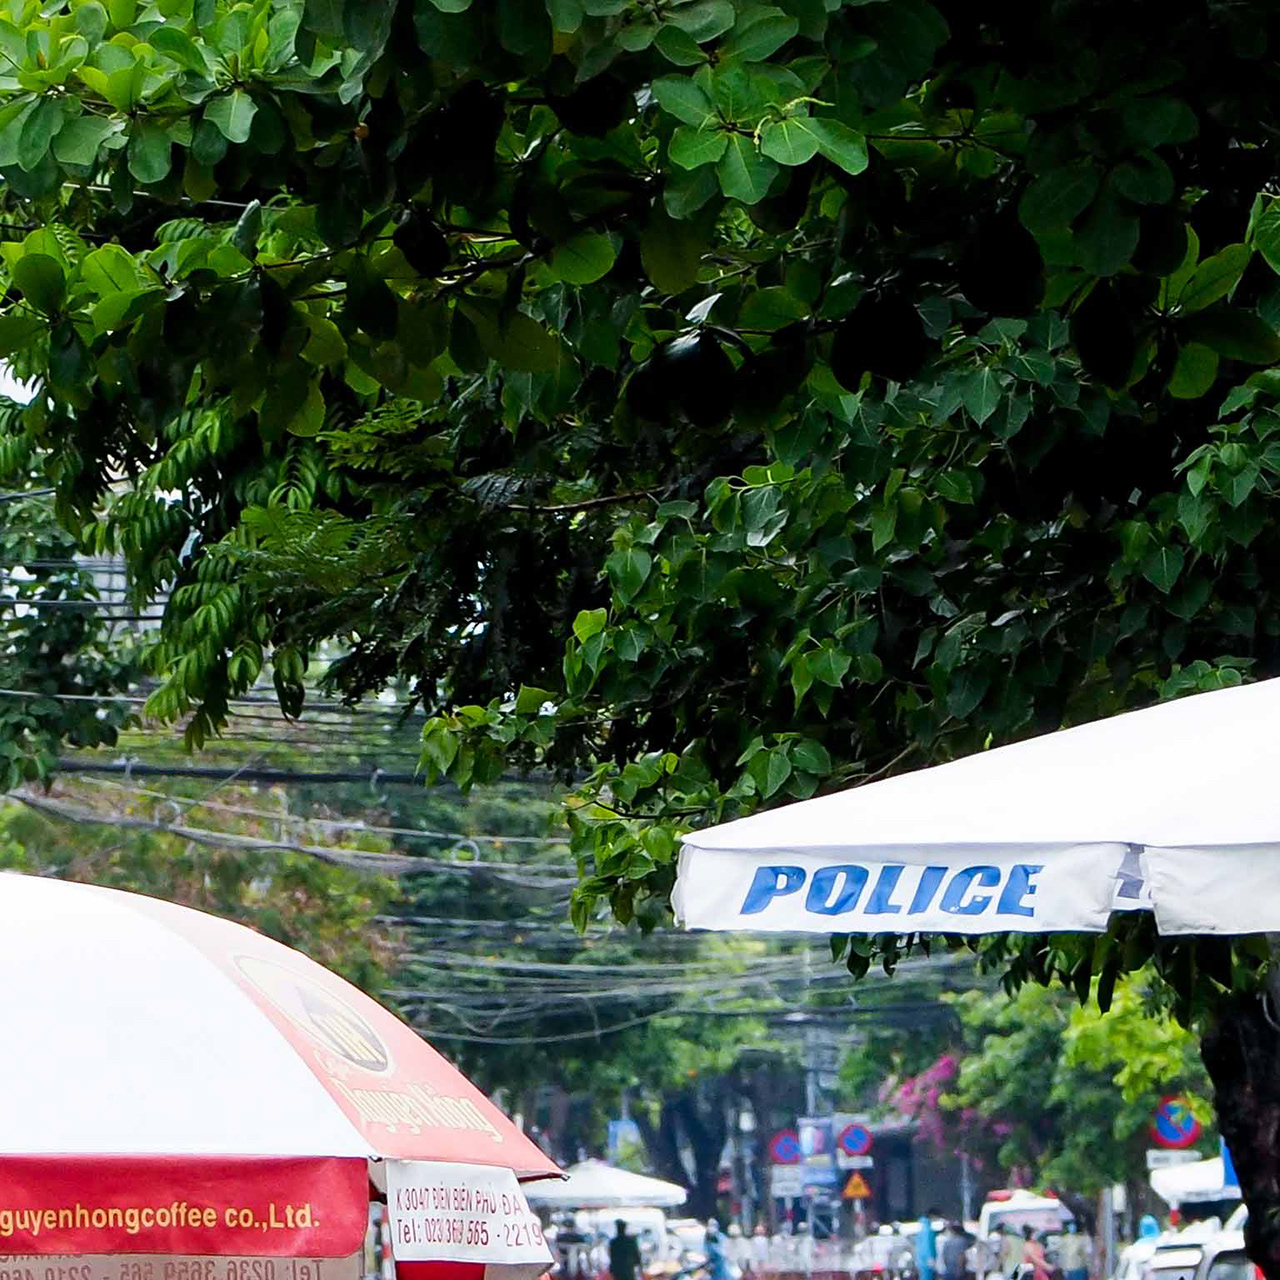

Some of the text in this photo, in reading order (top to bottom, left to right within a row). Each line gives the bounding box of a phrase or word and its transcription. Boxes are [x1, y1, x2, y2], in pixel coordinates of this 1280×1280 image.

[740, 863, 1045, 917] POLICE
[224, 1203, 321, 1233] co.,Ltd.
[397, 1219, 422, 1244] Tel:
